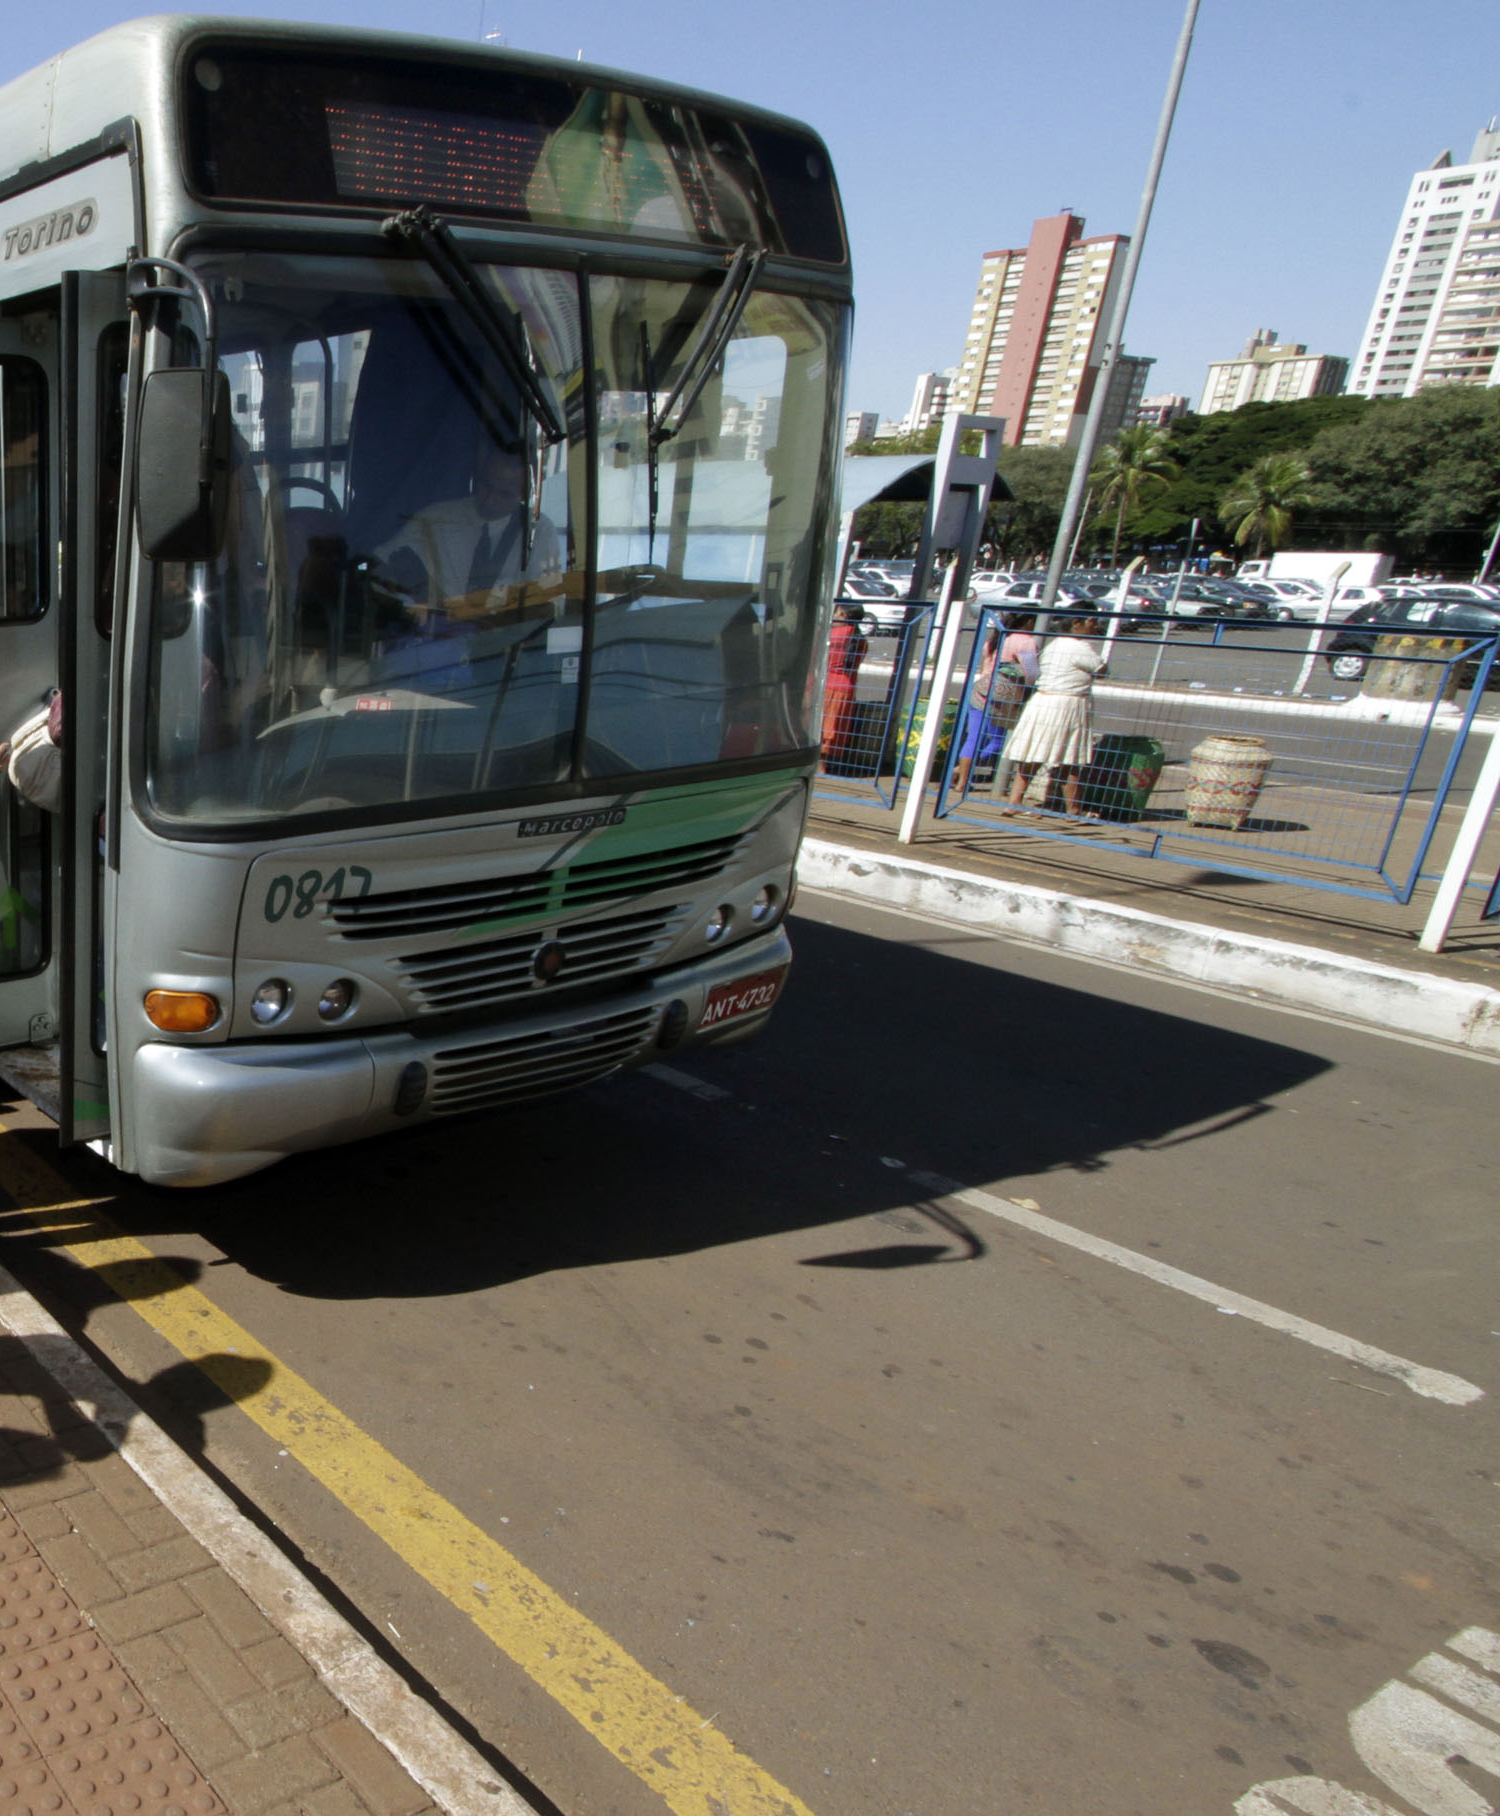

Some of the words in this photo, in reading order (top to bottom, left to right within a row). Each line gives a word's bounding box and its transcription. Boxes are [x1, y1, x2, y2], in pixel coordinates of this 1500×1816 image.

[3, 206, 93, 261] Torino
[523, 810, 625, 833] Marcopolo
[264, 865, 373, 923] 0817
